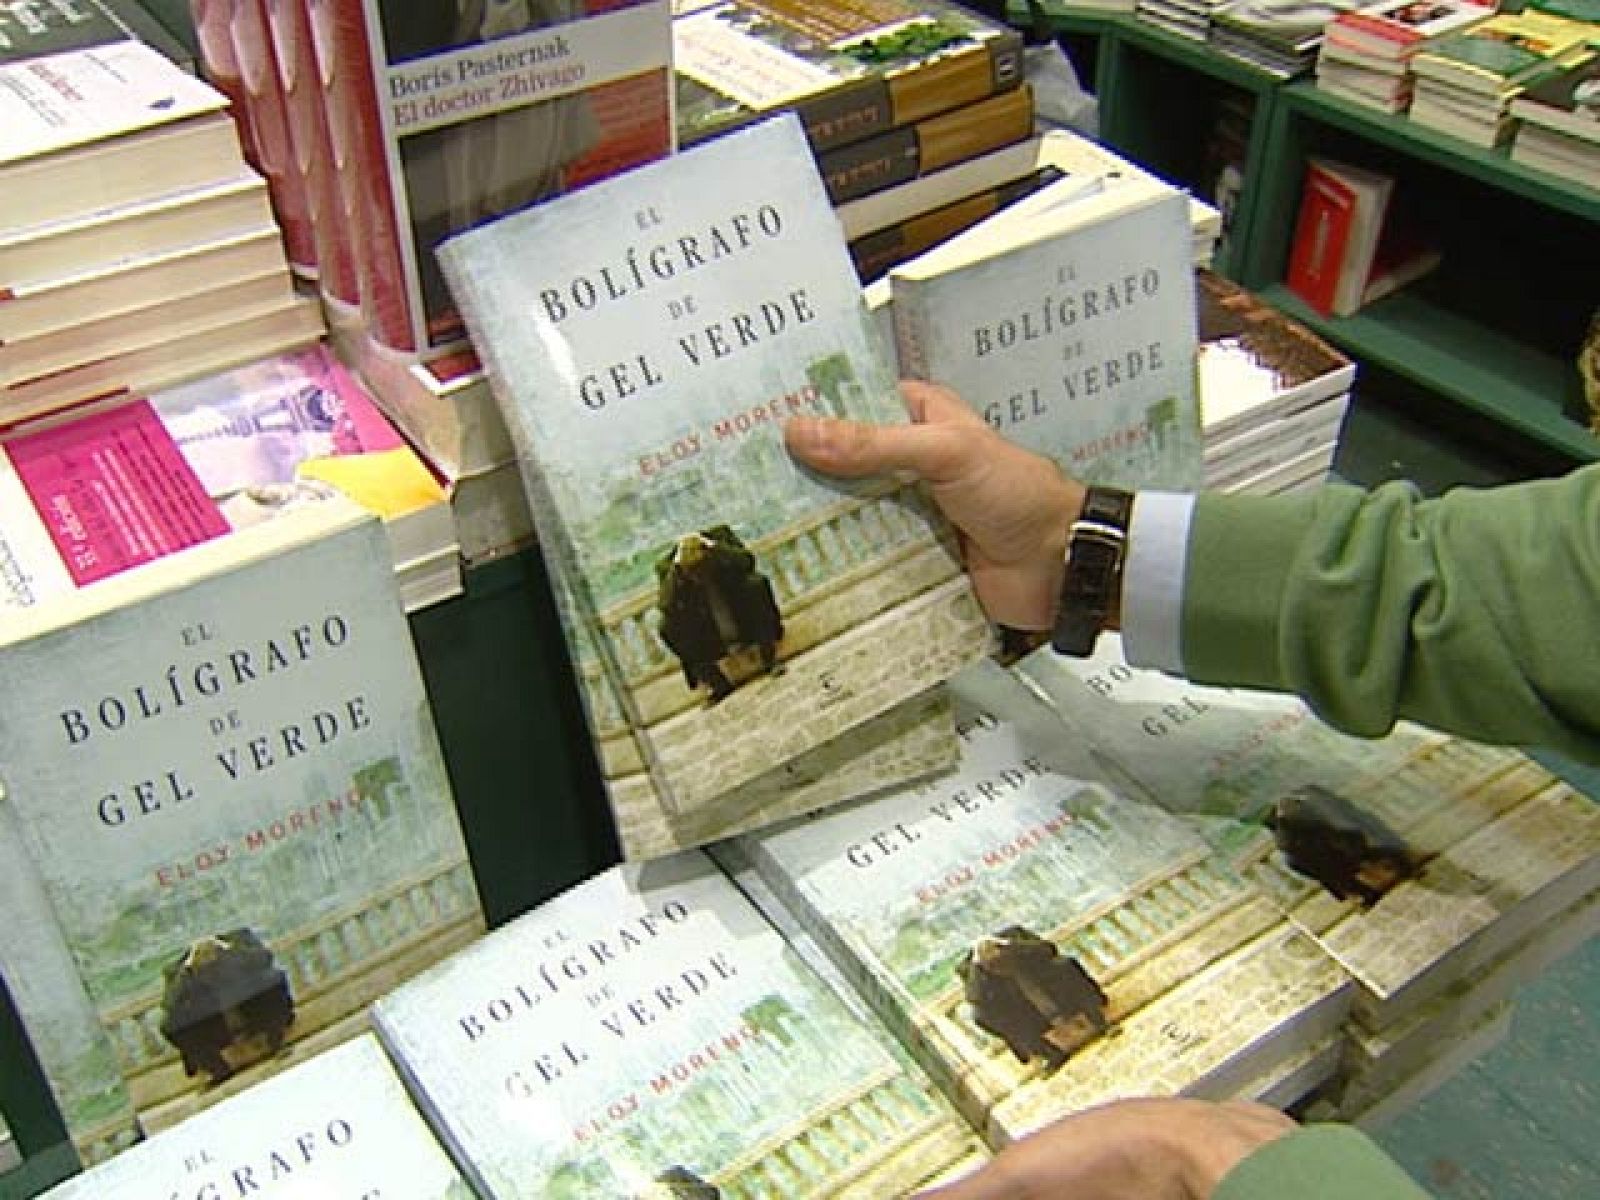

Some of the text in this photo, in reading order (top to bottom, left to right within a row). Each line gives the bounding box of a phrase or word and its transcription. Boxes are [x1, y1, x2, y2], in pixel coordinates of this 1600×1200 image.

[388, 35, 572, 99] Boris Pasternak
[393, 63, 587, 127] El doctor Zhivago
[633, 206, 664, 230] EL
[539, 202, 785, 326] BOLÍGRAFO
[667, 294, 698, 321] DE
[579, 354, 665, 412] GEL
[678, 289, 819, 368] VERDE
[974, 267, 1162, 359] BOLÍGRAFO
[638, 383, 822, 477] ELOY MORENO
[984, 341, 1165, 431] GEL VERDE
[60, 612, 350, 746] BOLÍGRAFO
[180, 622, 214, 648] EL
[208, 708, 243, 737] DE
[1141, 695, 1210, 736] GEL
[96, 695, 372, 829] GEL VERDE
[155, 786, 367, 888] ELOY MORENO
[846, 756, 1051, 869] GEL VERDE
[457, 899, 690, 1042] BOLÍGRAFO
[541, 928, 569, 949] EL
[503, 948, 740, 1102] GEL VERDE
[572, 1022, 764, 1142] ELOY MORENO
[170, 1118, 352, 1200] GRAFO
[183, 1148, 216, 1174] EL
